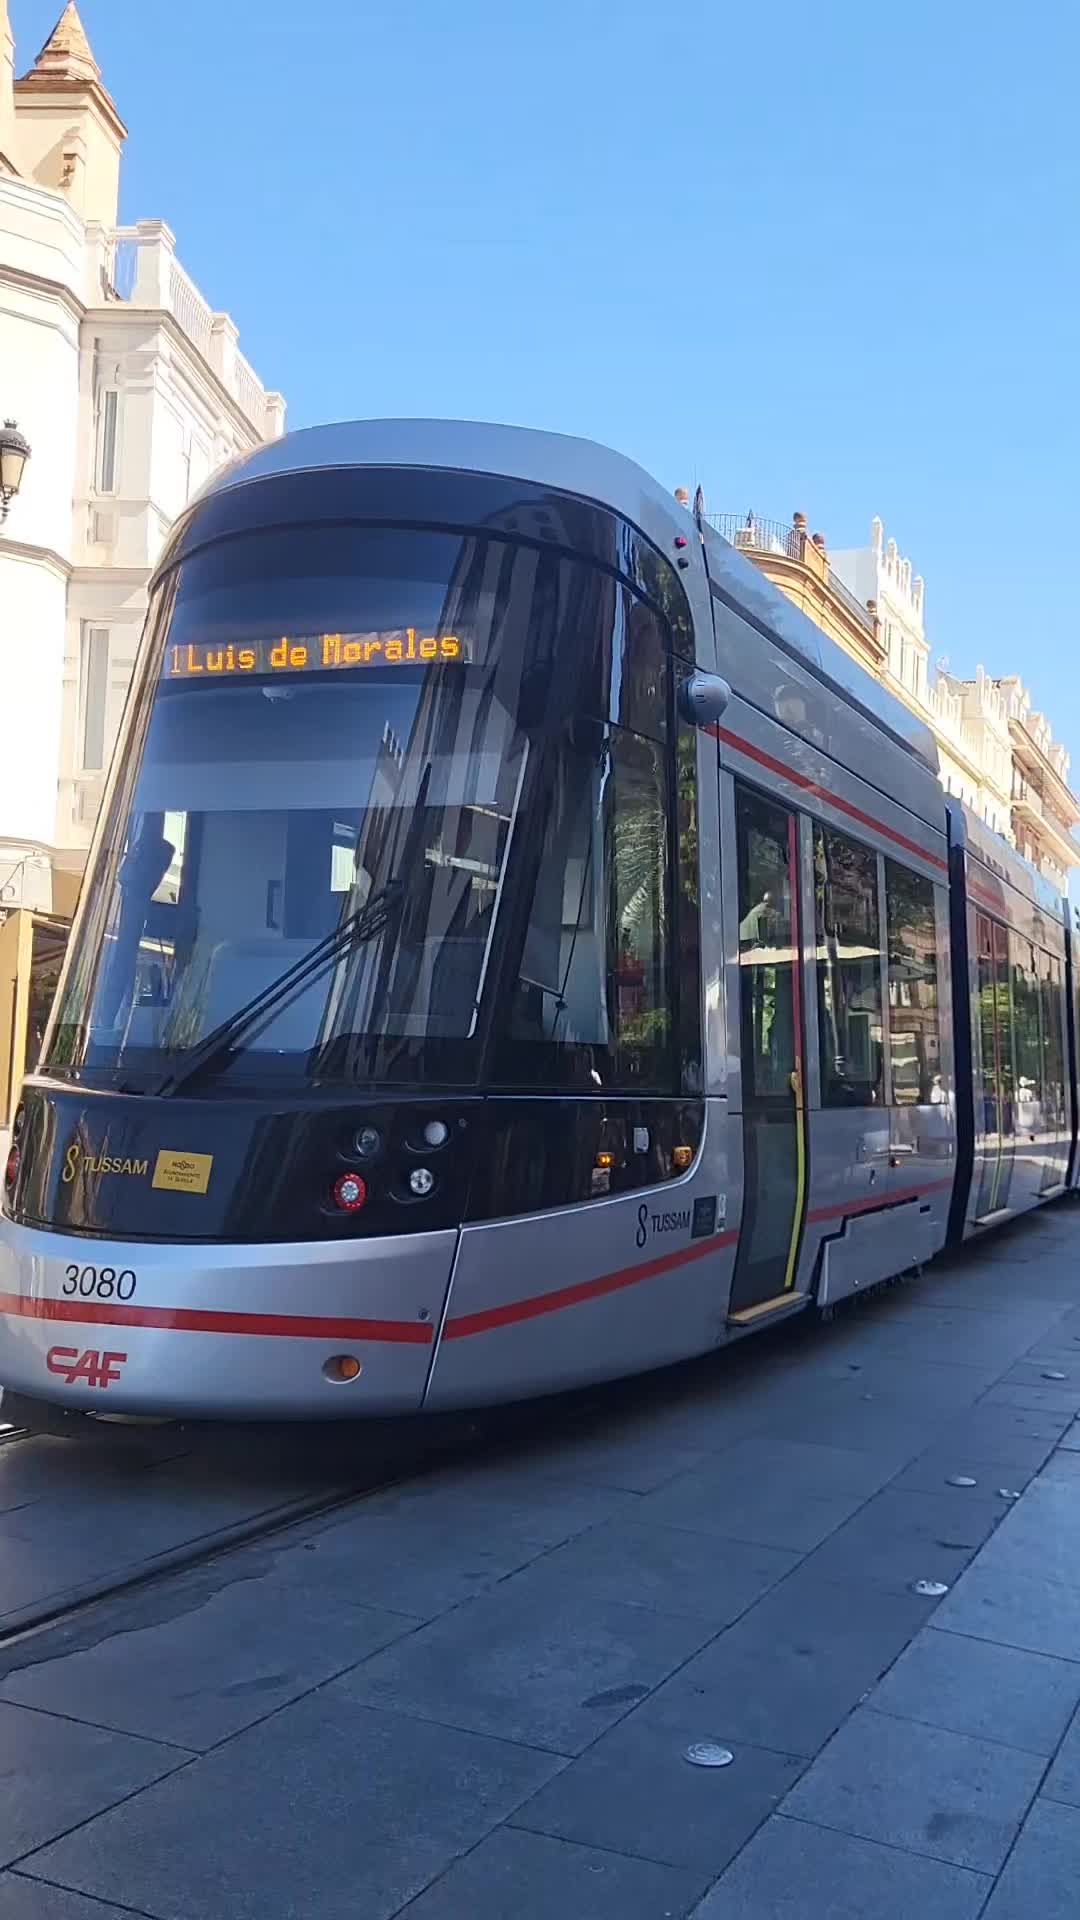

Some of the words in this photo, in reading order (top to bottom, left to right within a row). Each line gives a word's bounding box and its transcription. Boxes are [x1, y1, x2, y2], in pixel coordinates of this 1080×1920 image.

[187, 645, 255, 672] Luis
[271, 636, 307, 667] de
[322, 628, 459, 664] Morales
[83, 1156, 148, 1175] TUSSAM
[651, 1211, 690, 1232] TUSSAM
[63, 1265, 136, 1300] 3080
[46, 1346, 128, 1388] CAF
